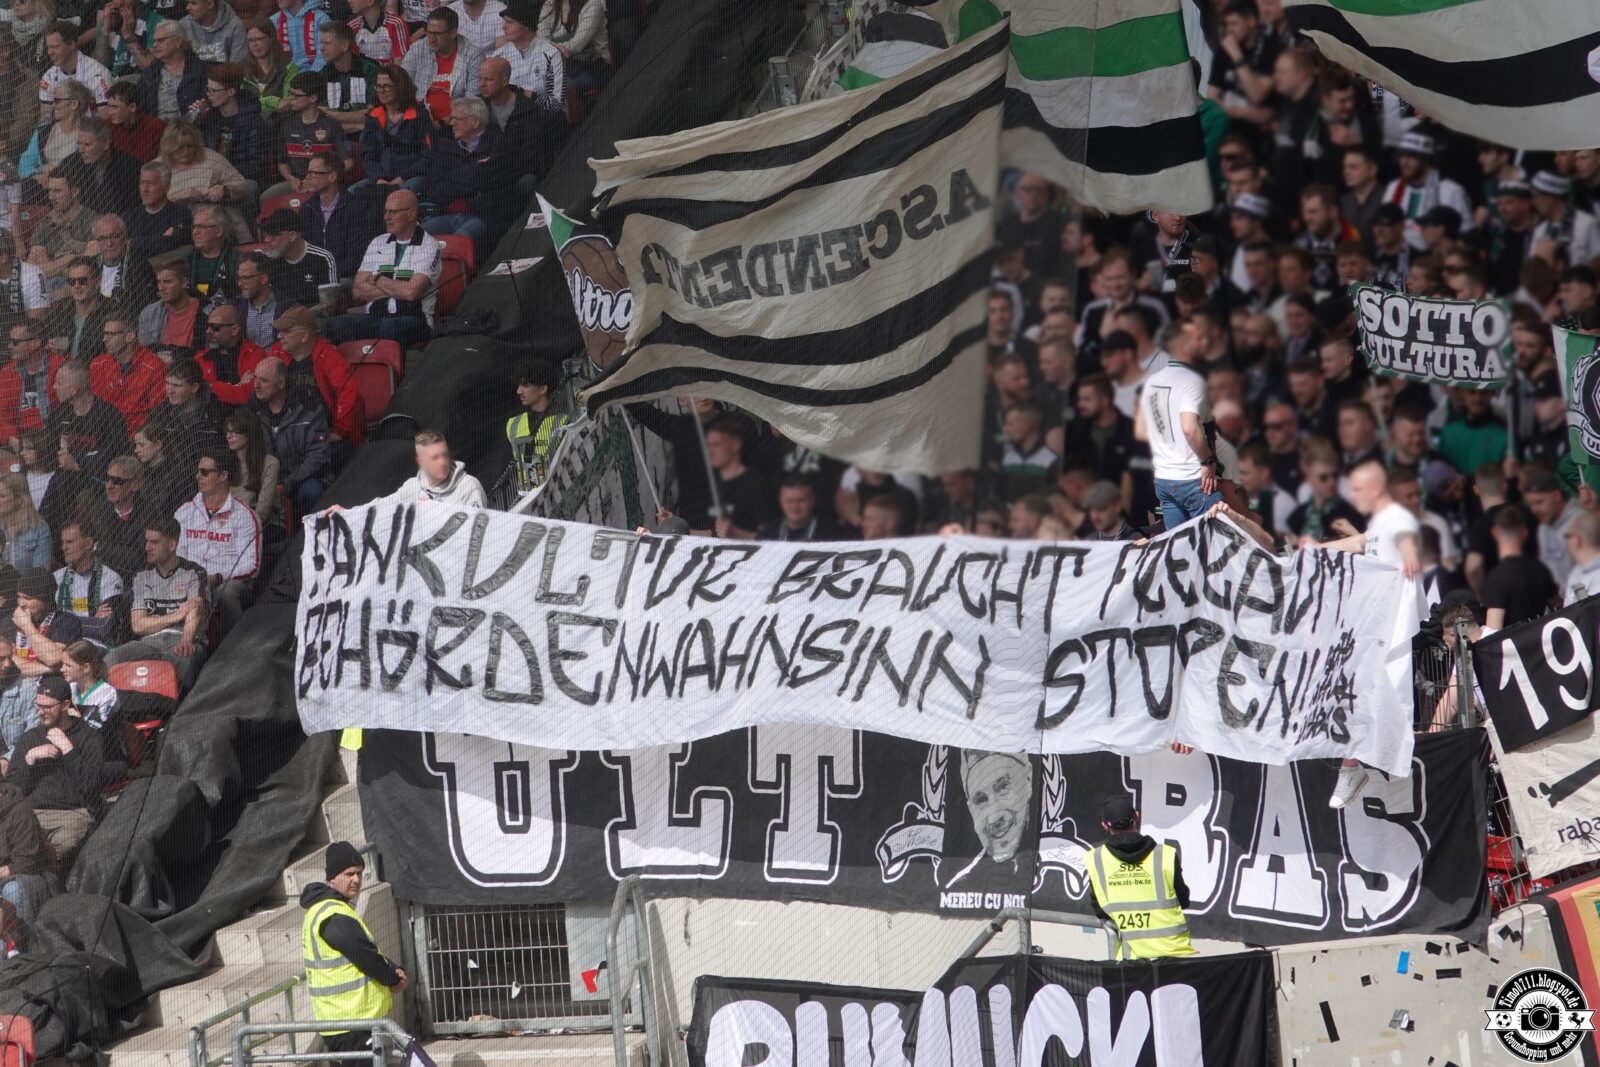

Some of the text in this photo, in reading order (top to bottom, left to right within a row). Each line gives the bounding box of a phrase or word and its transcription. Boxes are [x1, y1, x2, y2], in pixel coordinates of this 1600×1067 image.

[1356, 287, 1509, 347] SOTTO
[1364, 331, 1508, 380] CULTURA
[765, 542, 1091, 634] BRAUCHT
[1119, 862, 1143, 872] SDS
[940, 891, 983, 909] MEREU
[984, 892, 1001, 909] CU
[1118, 912, 1151, 930] 2437
